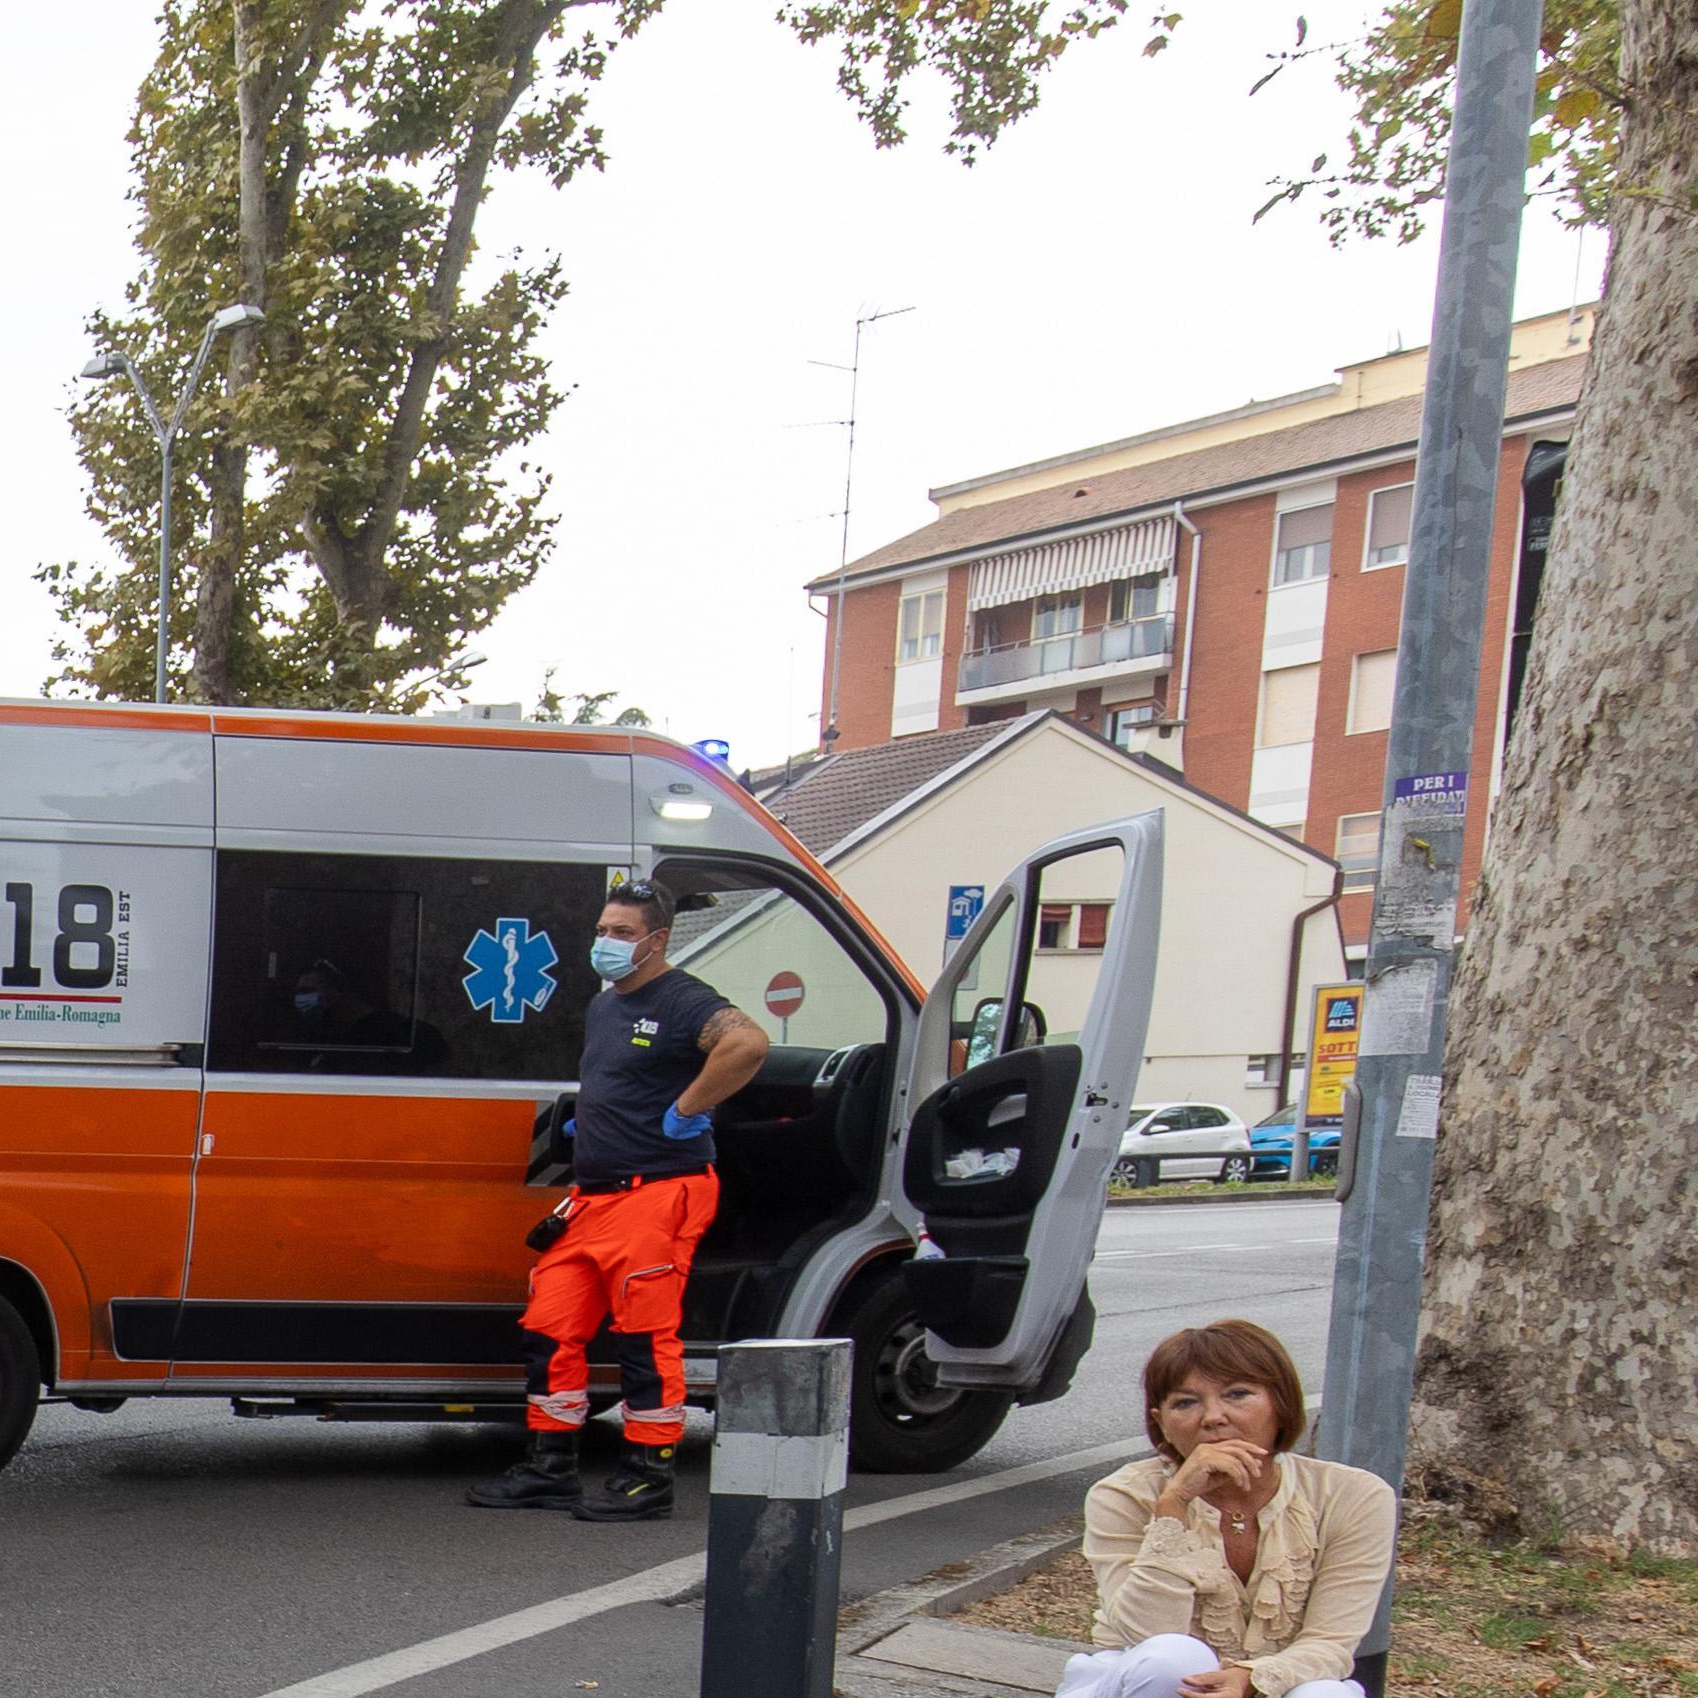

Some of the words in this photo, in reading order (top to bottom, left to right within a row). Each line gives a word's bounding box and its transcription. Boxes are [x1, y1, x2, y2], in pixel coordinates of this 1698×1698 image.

[1413, 776, 1445, 791] PER
[1447, 775, 1455, 787] I
[118, 891, 131, 922] EST
[116, 931, 130, 987] EMILIA
[15, 1003, 121, 1028] Emilia-Romagna
[1328, 1018, 1355, 1028] ALDI
